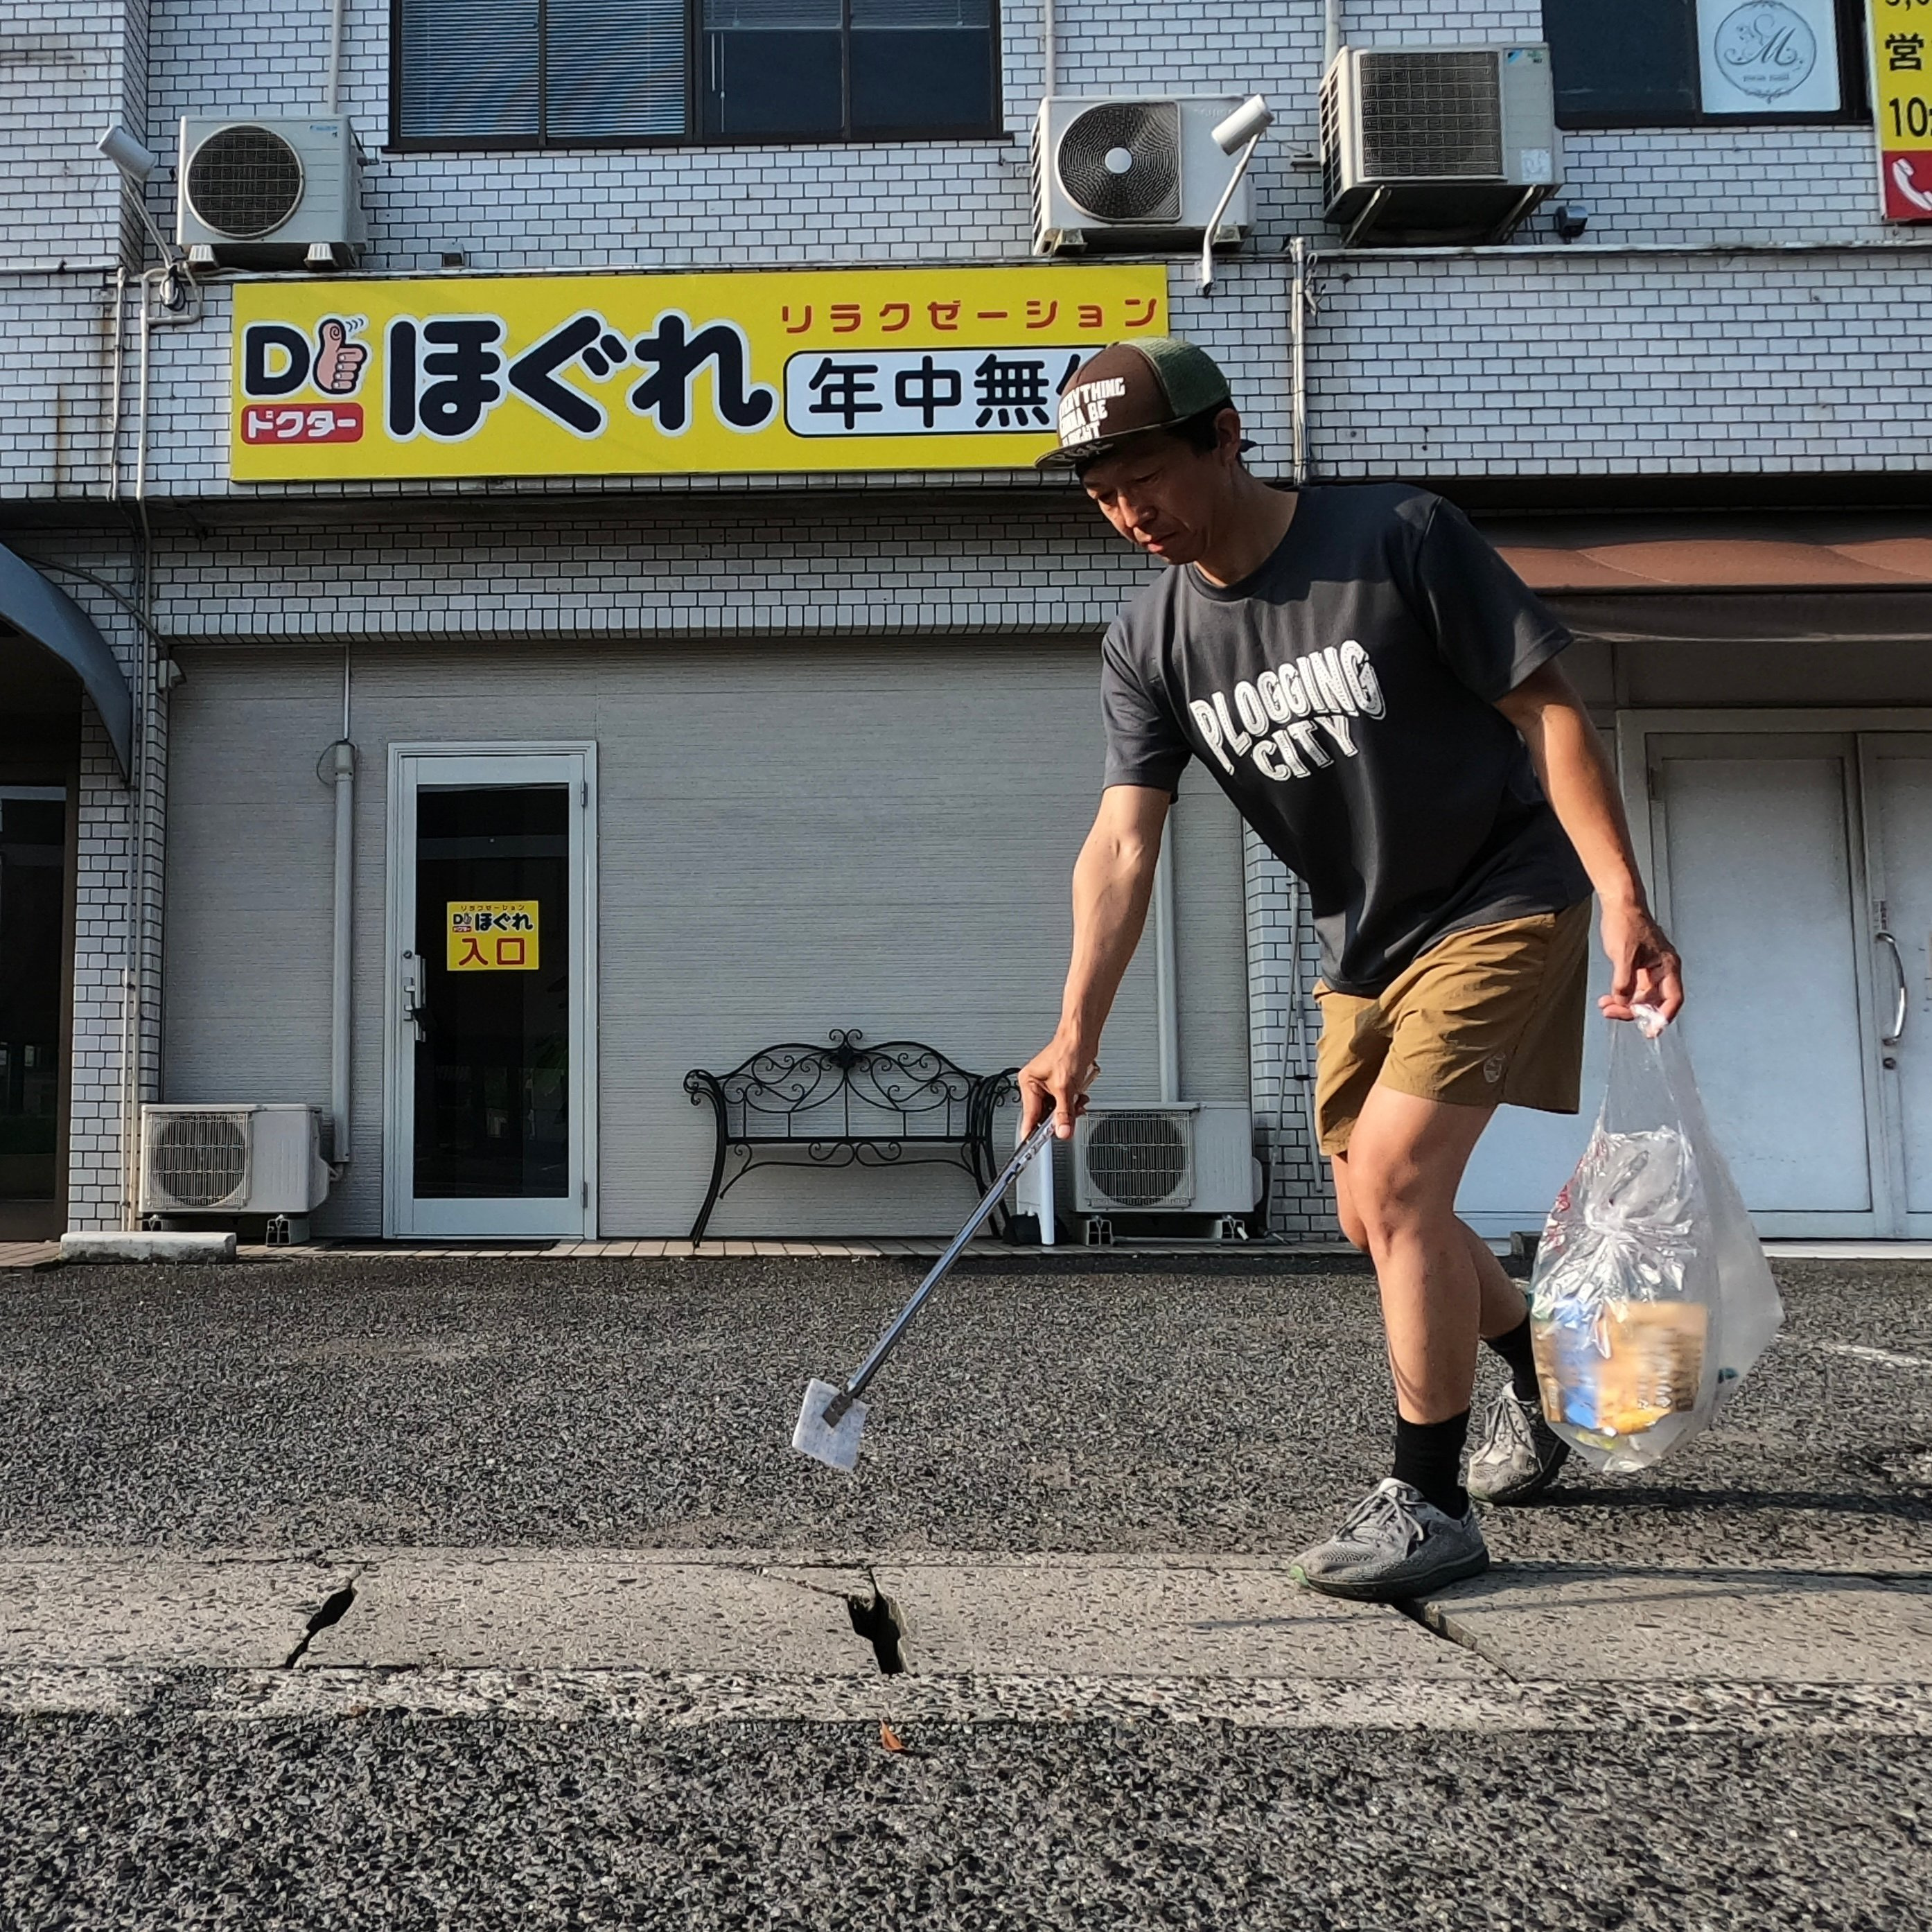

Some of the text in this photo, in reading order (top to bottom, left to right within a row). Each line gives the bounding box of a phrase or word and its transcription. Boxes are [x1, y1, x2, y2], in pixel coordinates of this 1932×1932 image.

[782, 299, 1157, 333] リラクゼーション
[389, 315, 773, 437] ほぐれ
[247, 410, 357, 439] ドクター
[1087, 398, 1108, 423] BE
[1188, 640, 1386, 776] PLOGGING
[1251, 714, 1359, 782] CITY
[475, 913, 533, 931] ほぐれ
[459, 938, 525, 965] 入口
